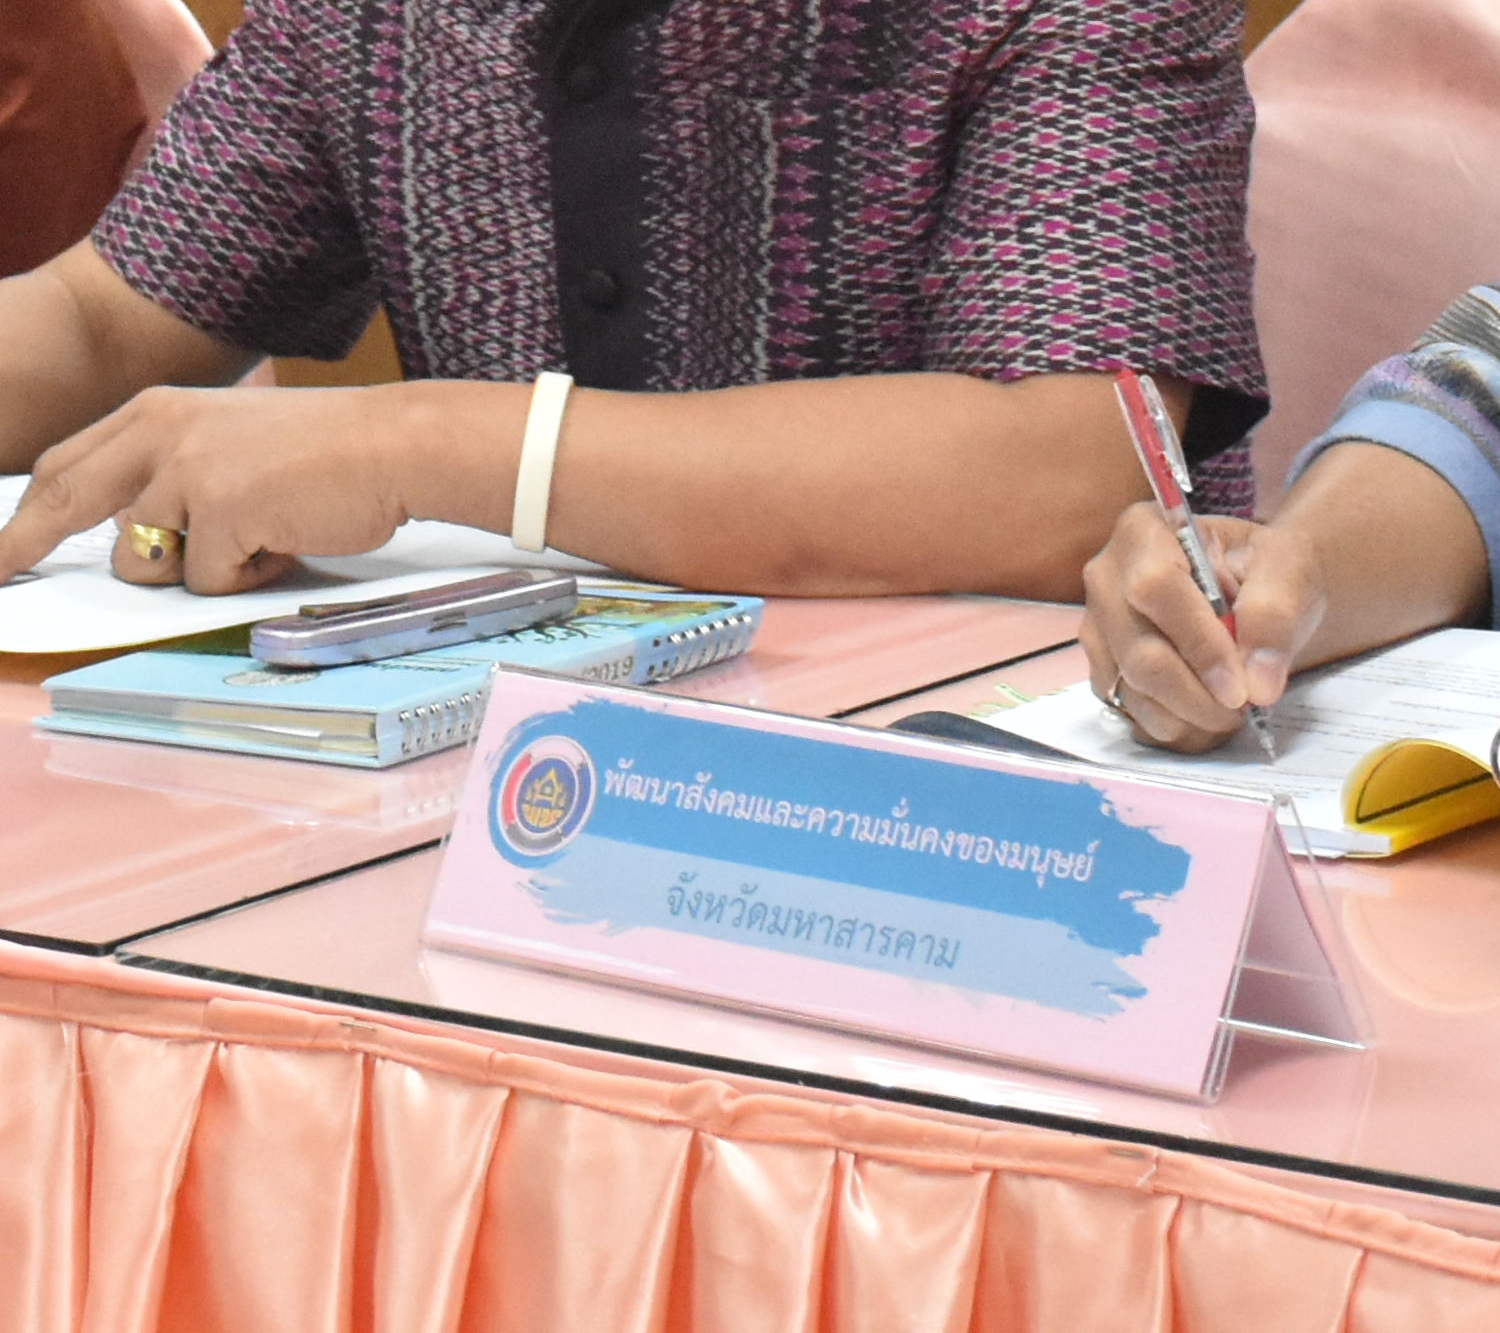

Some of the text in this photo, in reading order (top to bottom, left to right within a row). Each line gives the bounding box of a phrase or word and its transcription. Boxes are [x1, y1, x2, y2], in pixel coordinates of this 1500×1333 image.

[602, 755, 1098, 890] พัฒนาสังคมและความมั่นคงของมนุษย์
[665, 880, 962, 971] จังหวัดมหาสารคาม
